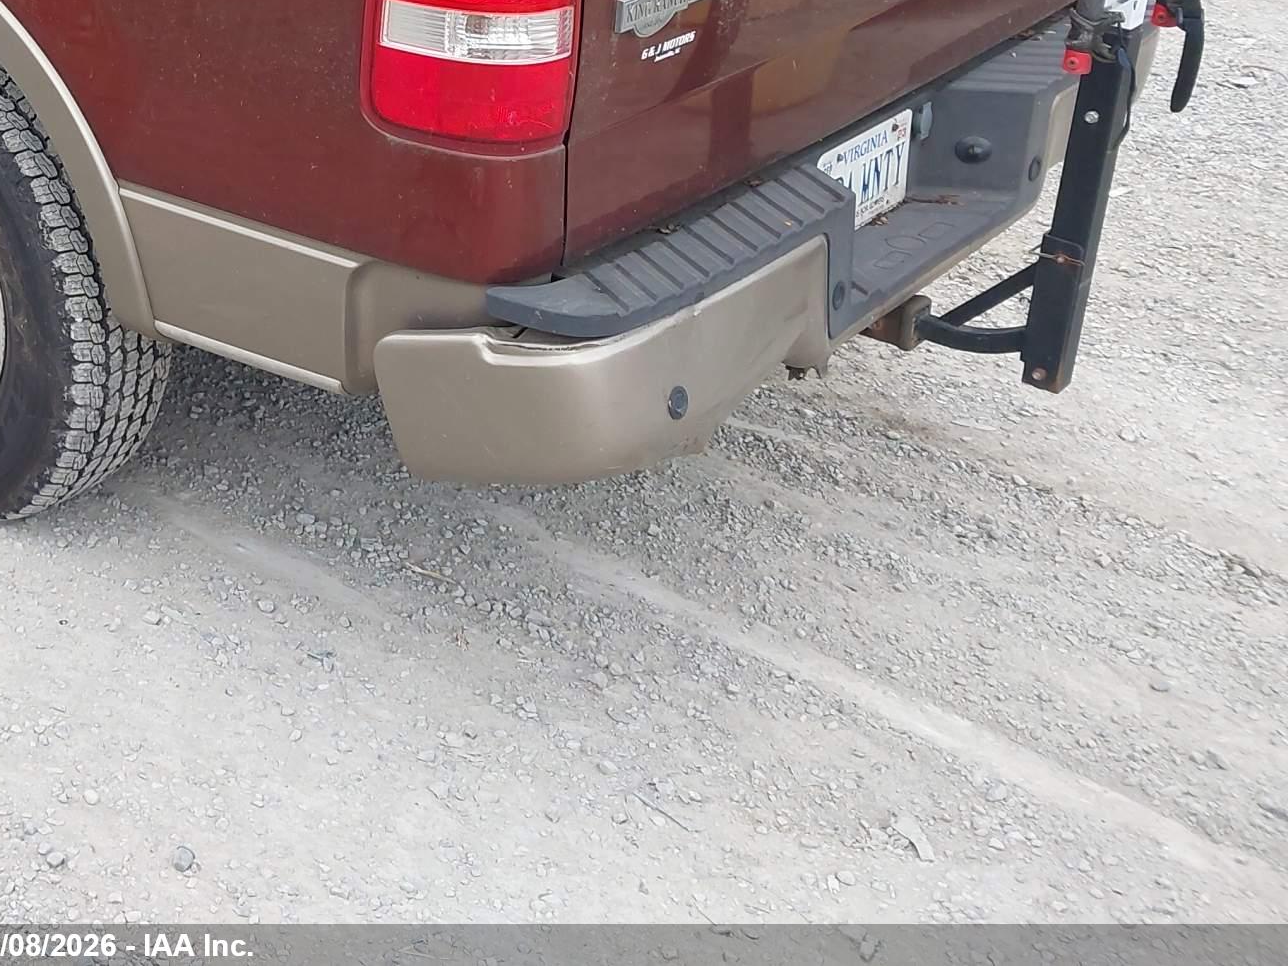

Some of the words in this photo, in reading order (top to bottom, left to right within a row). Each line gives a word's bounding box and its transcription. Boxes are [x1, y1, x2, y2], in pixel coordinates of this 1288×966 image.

[626, 0, 652, 24] KING
[662, 30, 697, 52] MOTORS
[843, 129, 888, 165] VIRGINIA
